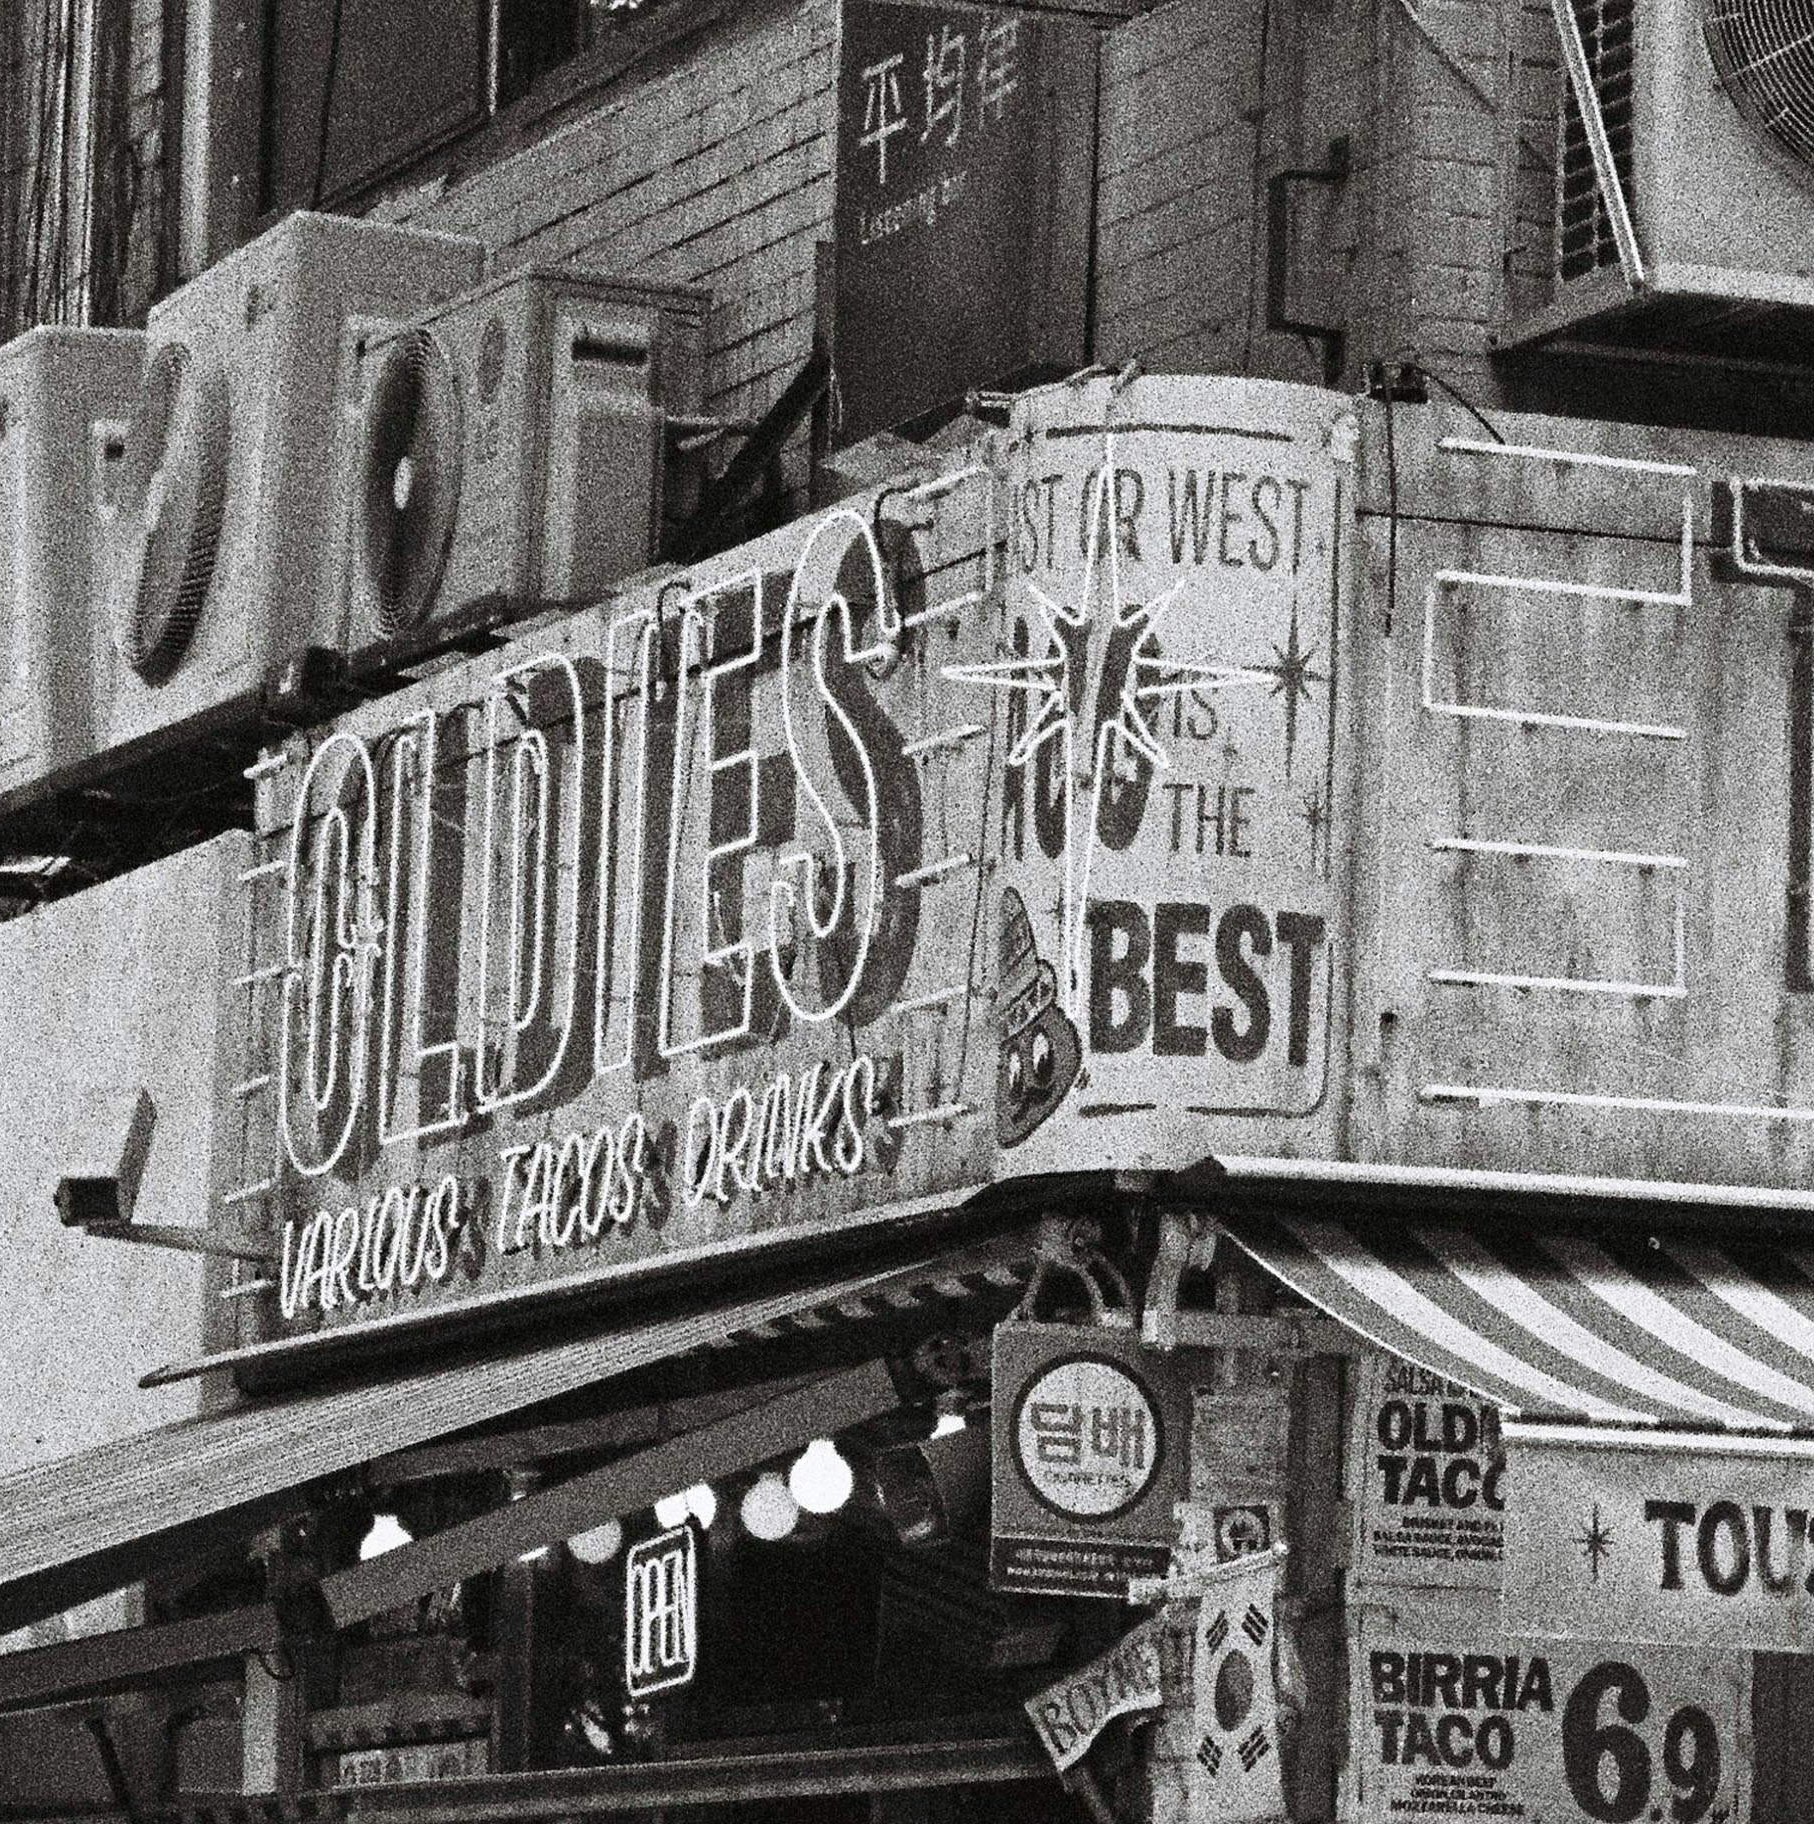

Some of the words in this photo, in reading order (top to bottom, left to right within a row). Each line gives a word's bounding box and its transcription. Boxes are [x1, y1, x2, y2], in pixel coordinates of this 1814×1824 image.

[1169, 469, 1311, 574] WEST
[282, 508, 923, 1176] OLDIES
[1163, 783, 1256, 858] THE
[1088, 900, 1326, 1068] BEST
[279, 1174, 460, 1319] VARIOUS
[497, 1113, 648, 1258] TACOS
[685, 1055, 877, 1203] DRINKS
[1031, 1401, 1147, 1471] 담배
[1369, 1650, 1554, 1713] BIRRIA
[1373, 1712, 1517, 1770] TACO
